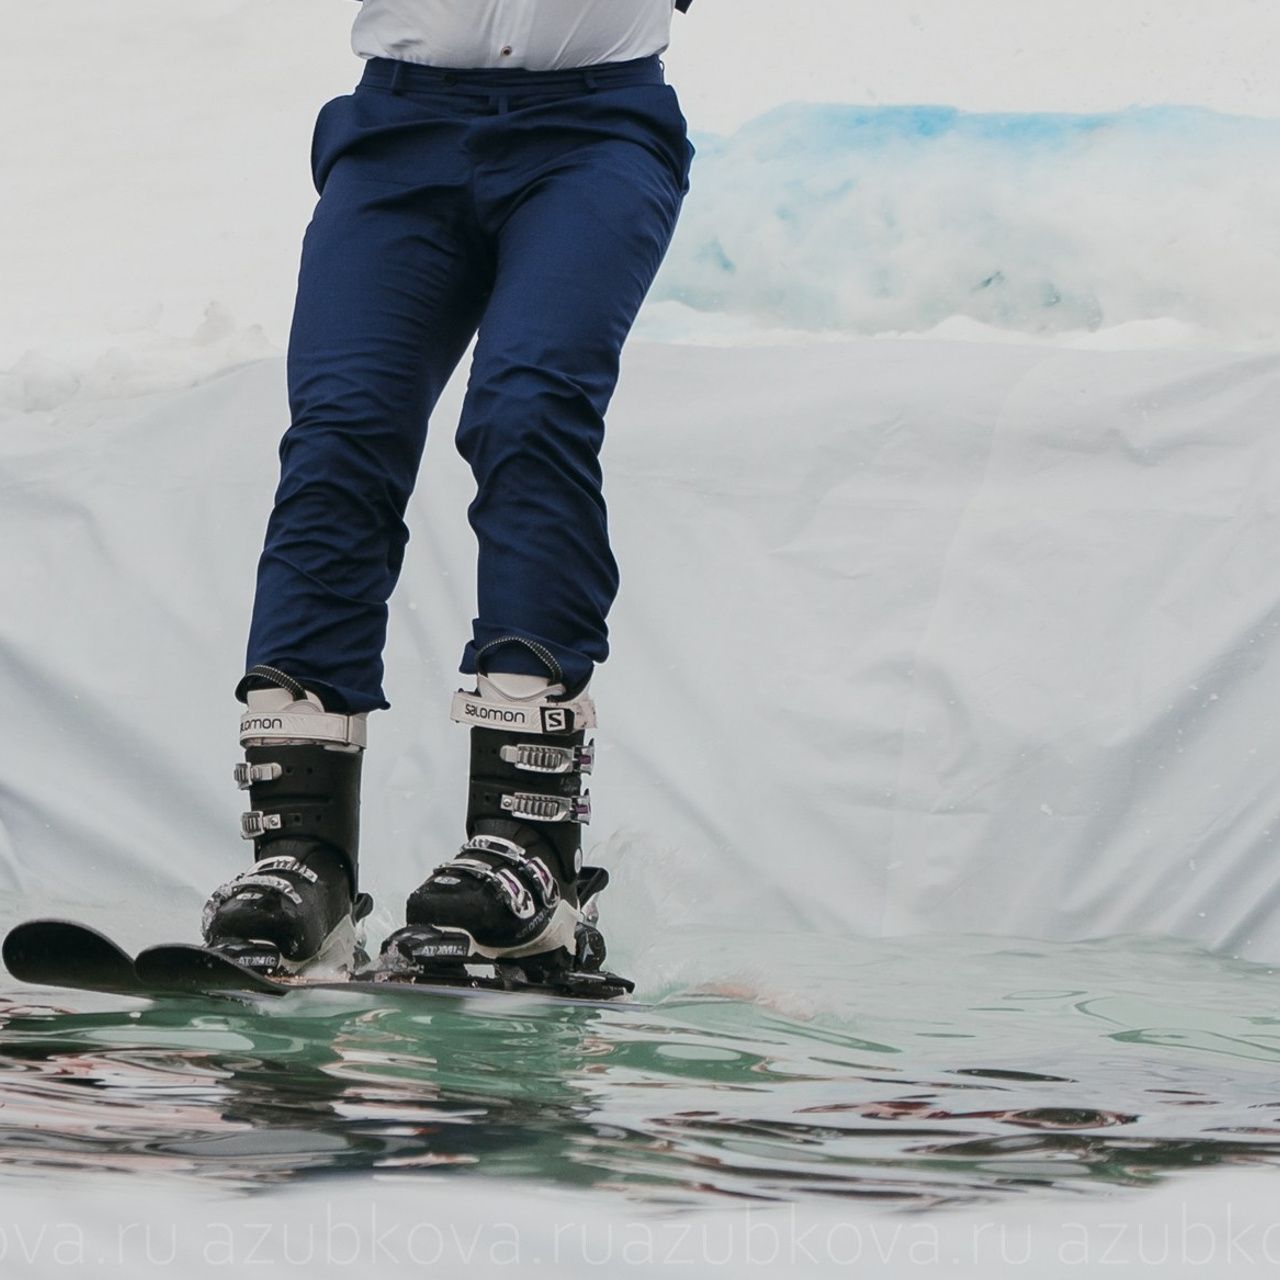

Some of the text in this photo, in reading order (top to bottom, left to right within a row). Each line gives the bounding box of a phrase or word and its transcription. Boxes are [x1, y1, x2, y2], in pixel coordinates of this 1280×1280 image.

[464, 703, 526, 724] salomon
[239, 718, 283, 734] lomon
[238, 955, 276, 967] ATOMIC
